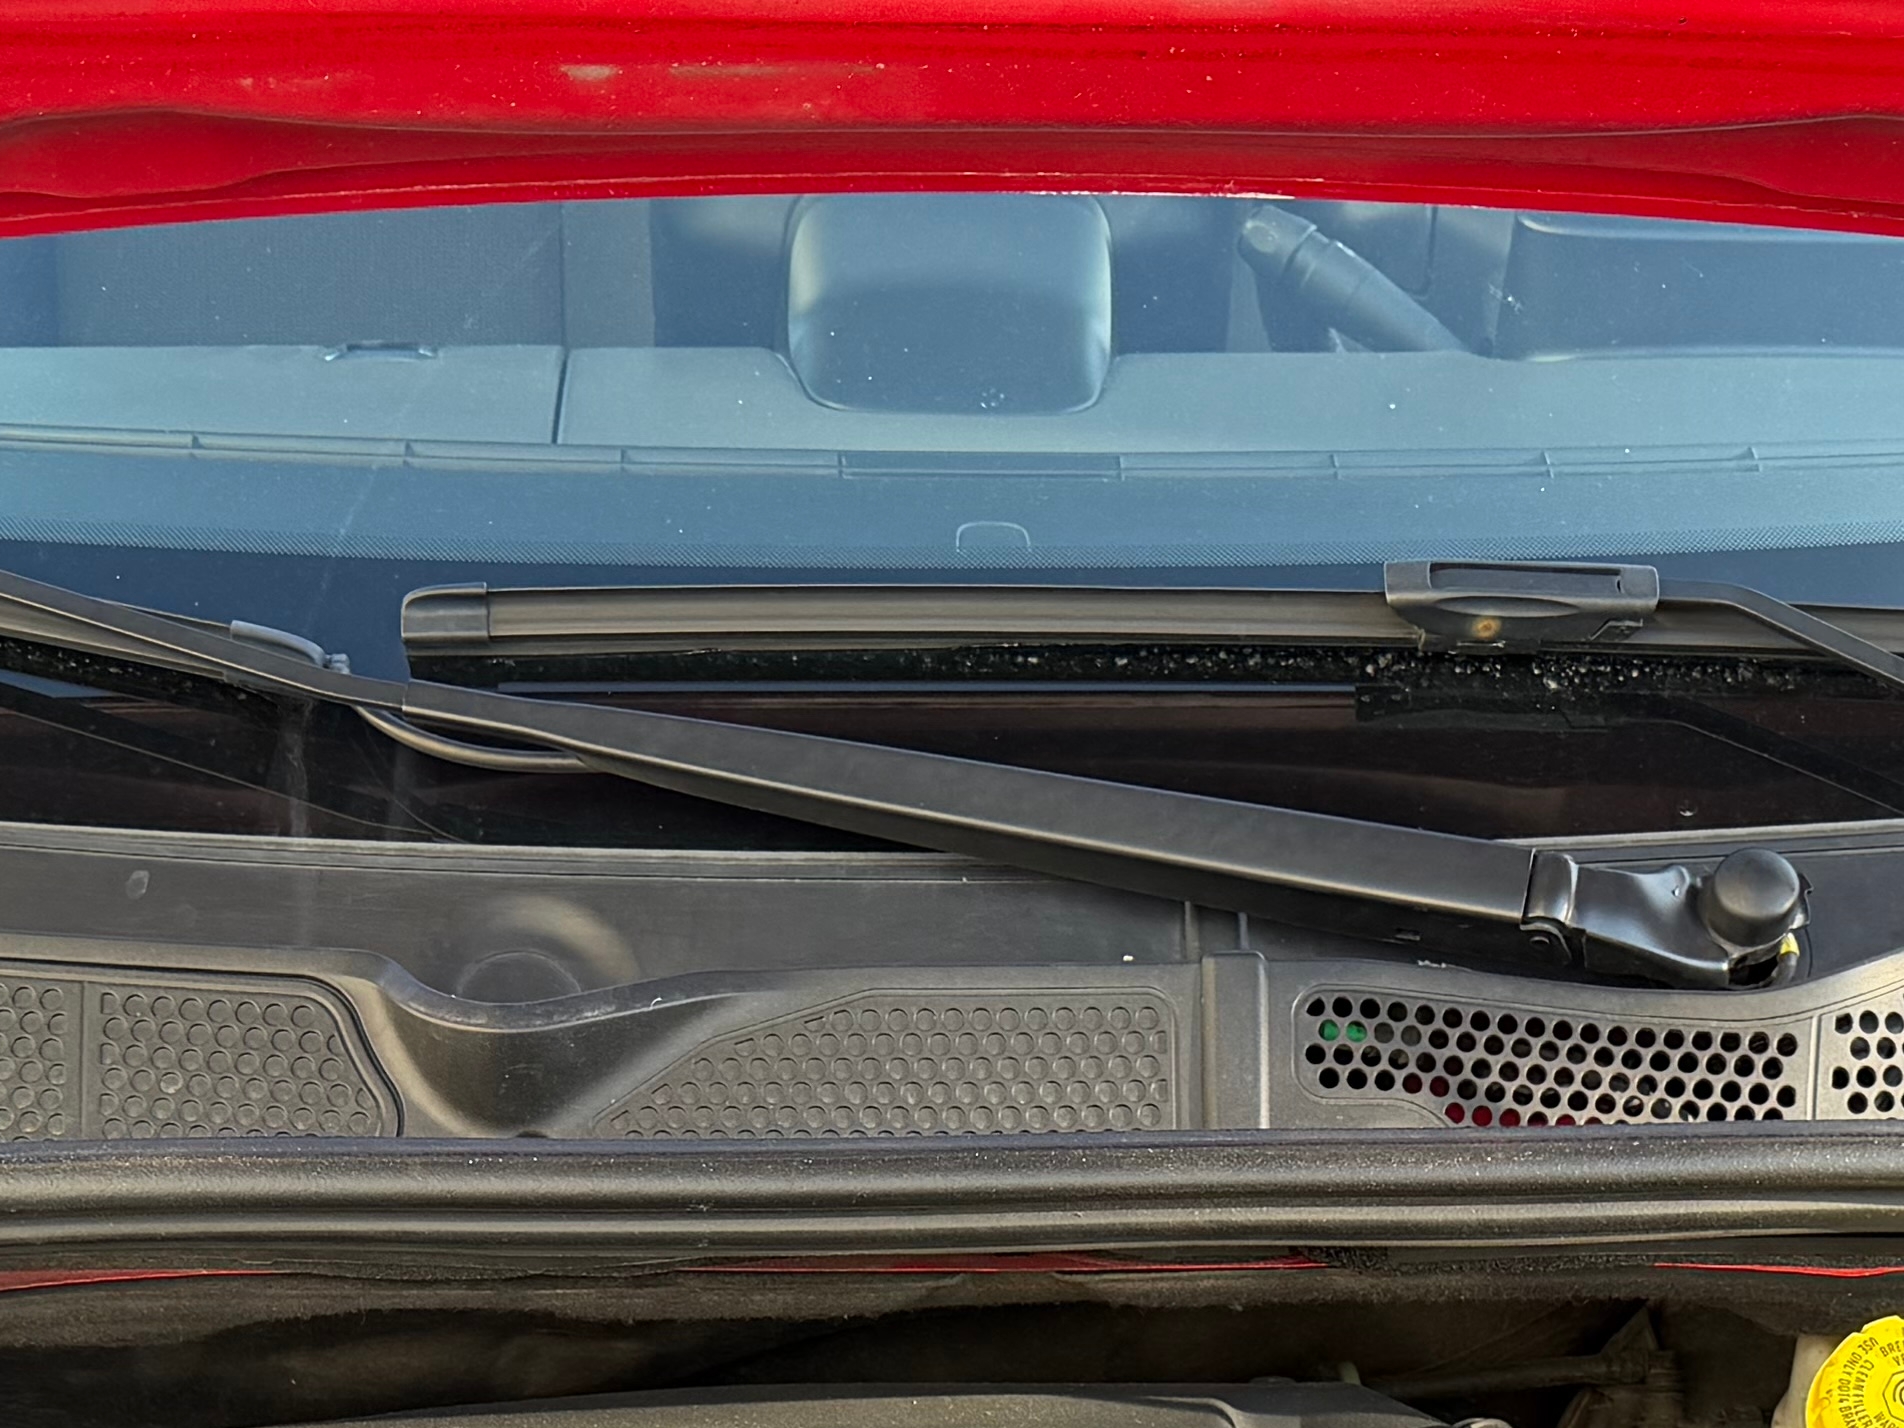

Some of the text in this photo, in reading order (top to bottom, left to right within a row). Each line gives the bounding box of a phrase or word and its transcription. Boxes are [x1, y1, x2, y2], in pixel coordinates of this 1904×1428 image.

[1857, 1337, 1879, 1354] USE
[1842, 1351, 1862, 1377] ONLY
[1852, 1359, 1875, 1393] CLEAN
[1852, 1394, 1873, 1428] FILLER
